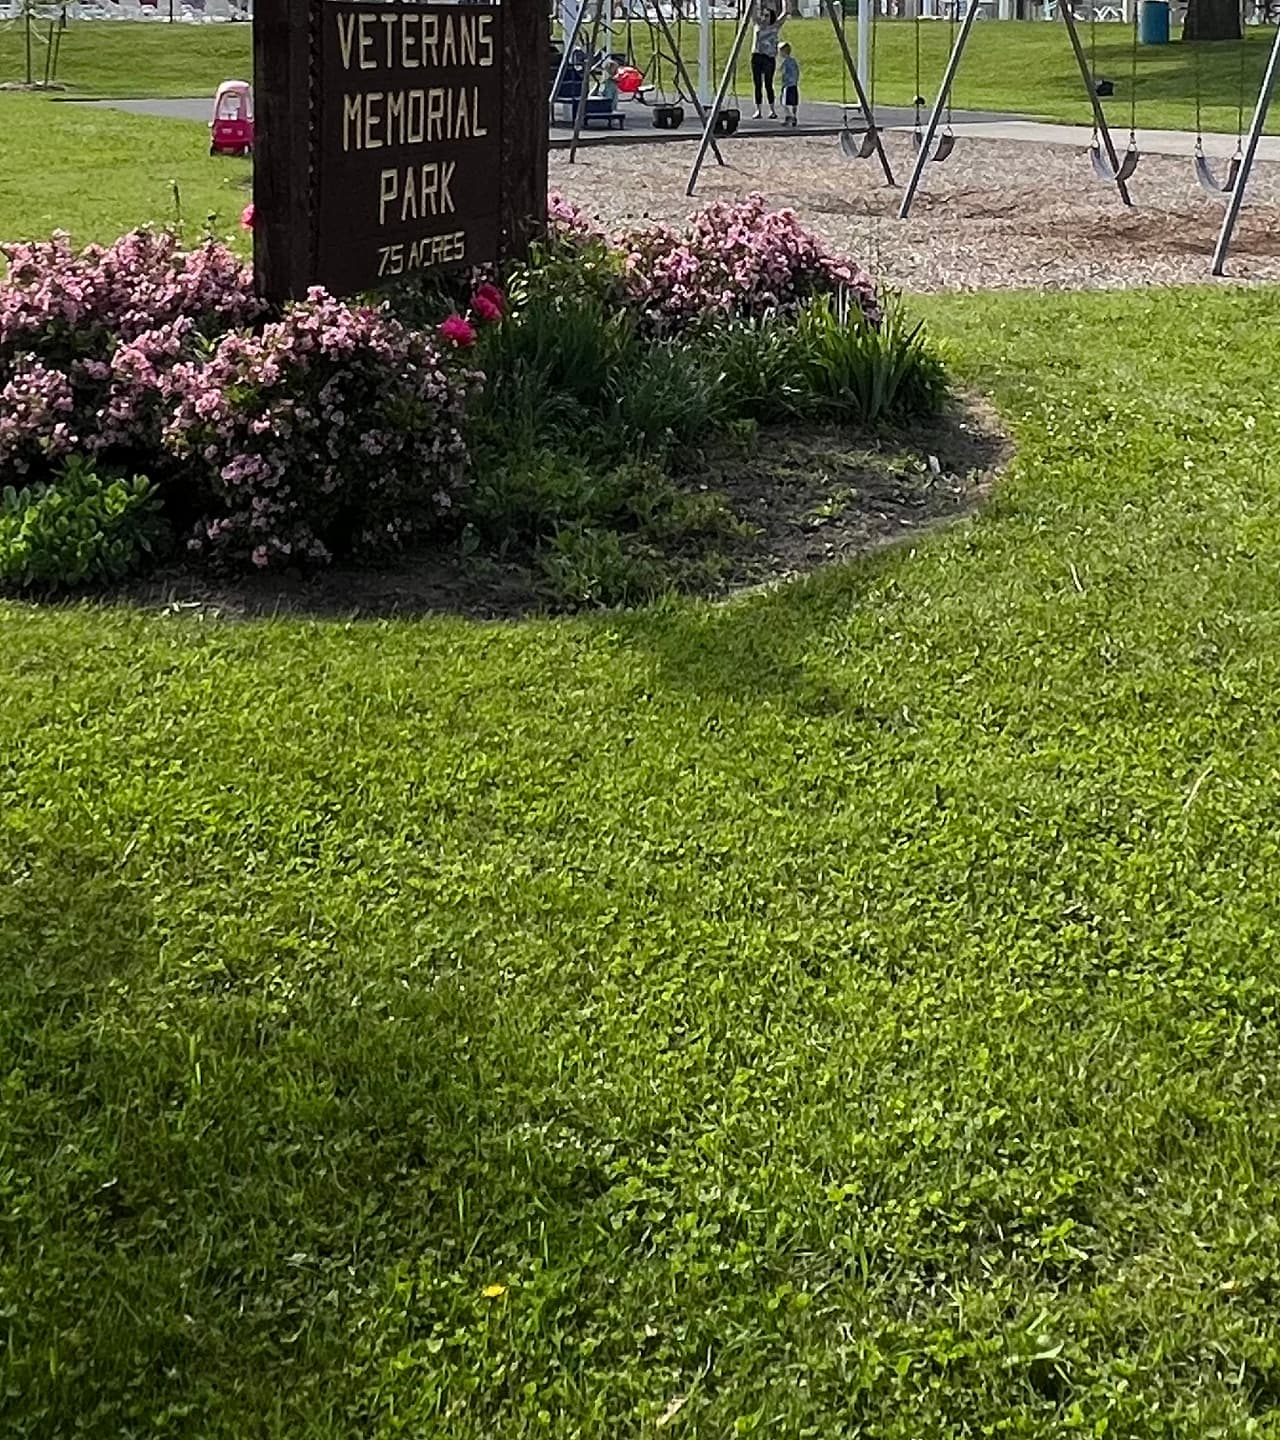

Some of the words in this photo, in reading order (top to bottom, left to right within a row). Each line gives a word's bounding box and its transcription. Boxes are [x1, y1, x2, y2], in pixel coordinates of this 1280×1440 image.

[337, 13, 493, 70] VETERANS
[343, 86, 487, 152] MEMORIAL
[380, 162, 456, 225] PARK
[407, 231, 465, 270] ACRES
